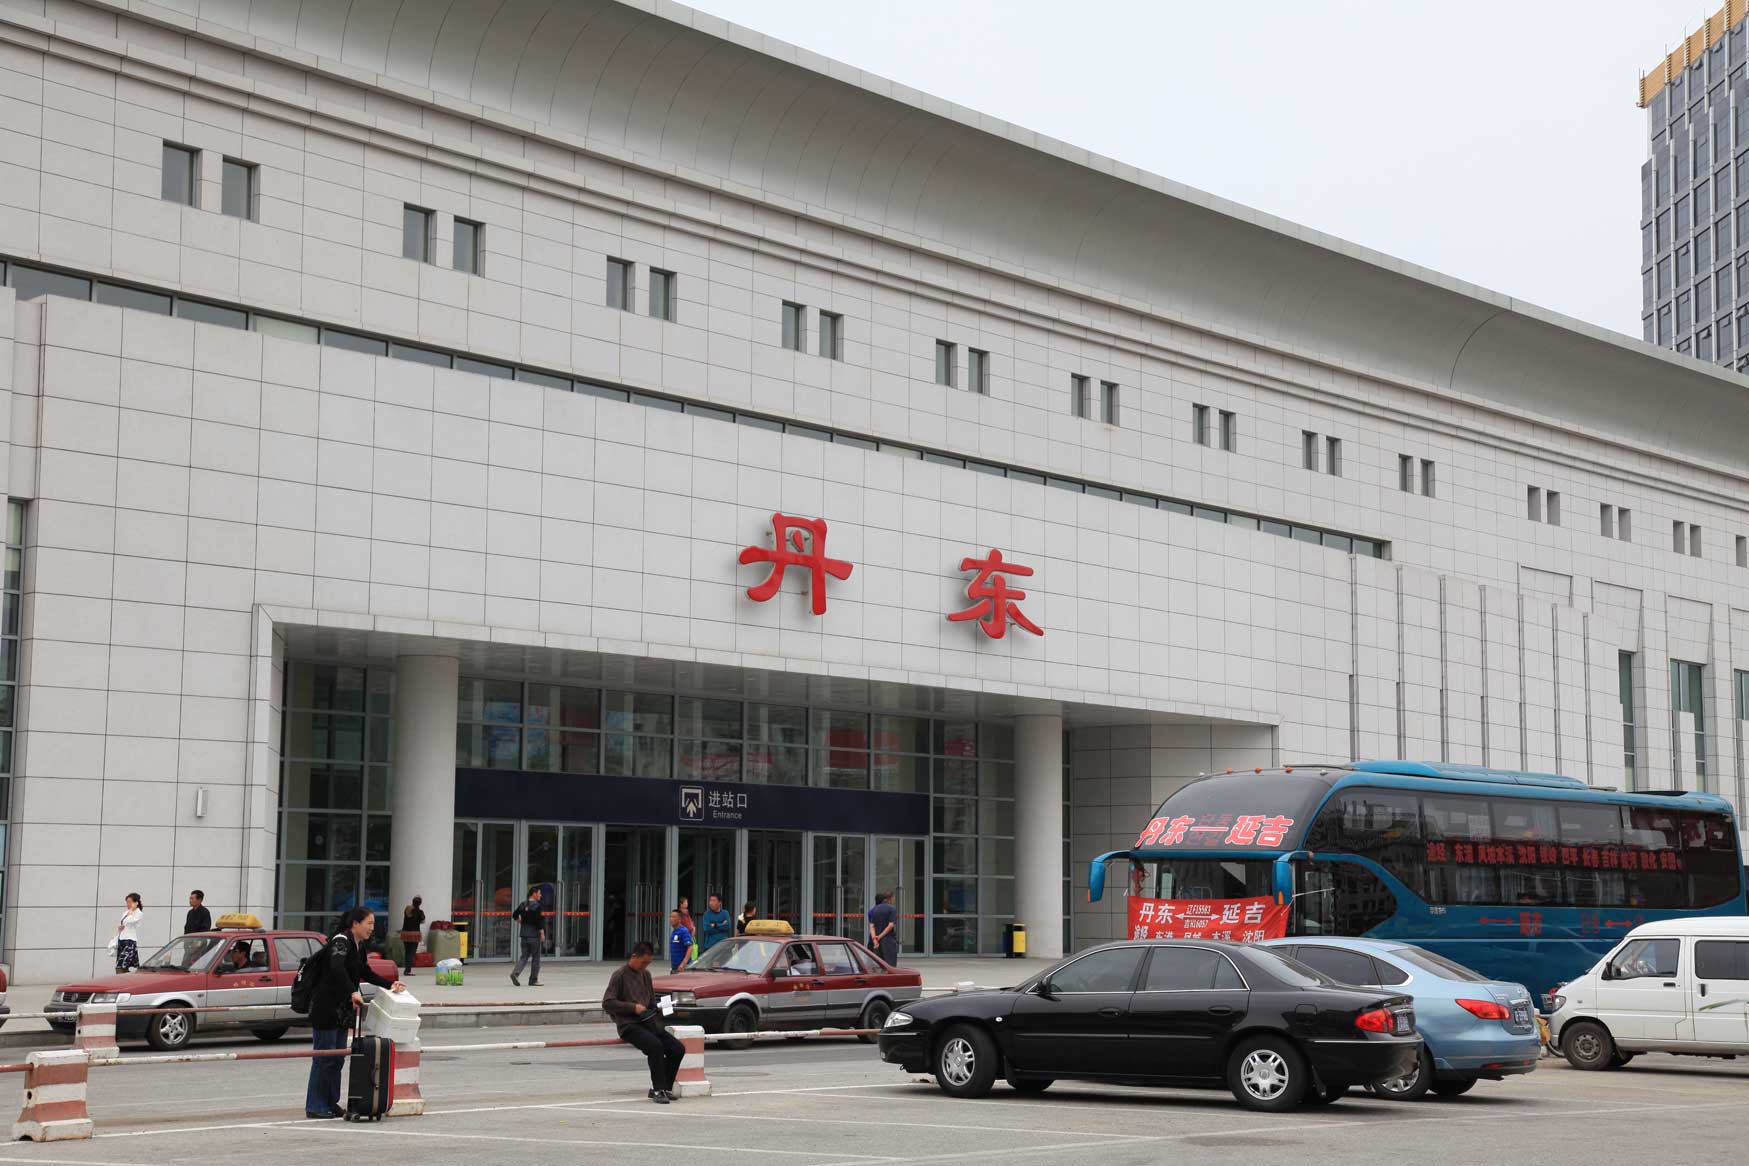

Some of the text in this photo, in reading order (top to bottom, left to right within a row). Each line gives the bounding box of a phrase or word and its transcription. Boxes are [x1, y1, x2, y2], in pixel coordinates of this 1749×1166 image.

[738, 512, 1044, 639] 丹东
[708, 790, 747, 809] 进站口
[712, 810, 742, 819] Entrance
[1139, 901, 1265, 924] 丹东 延吉
[1242, 929, 1265, 943] 沈阳
